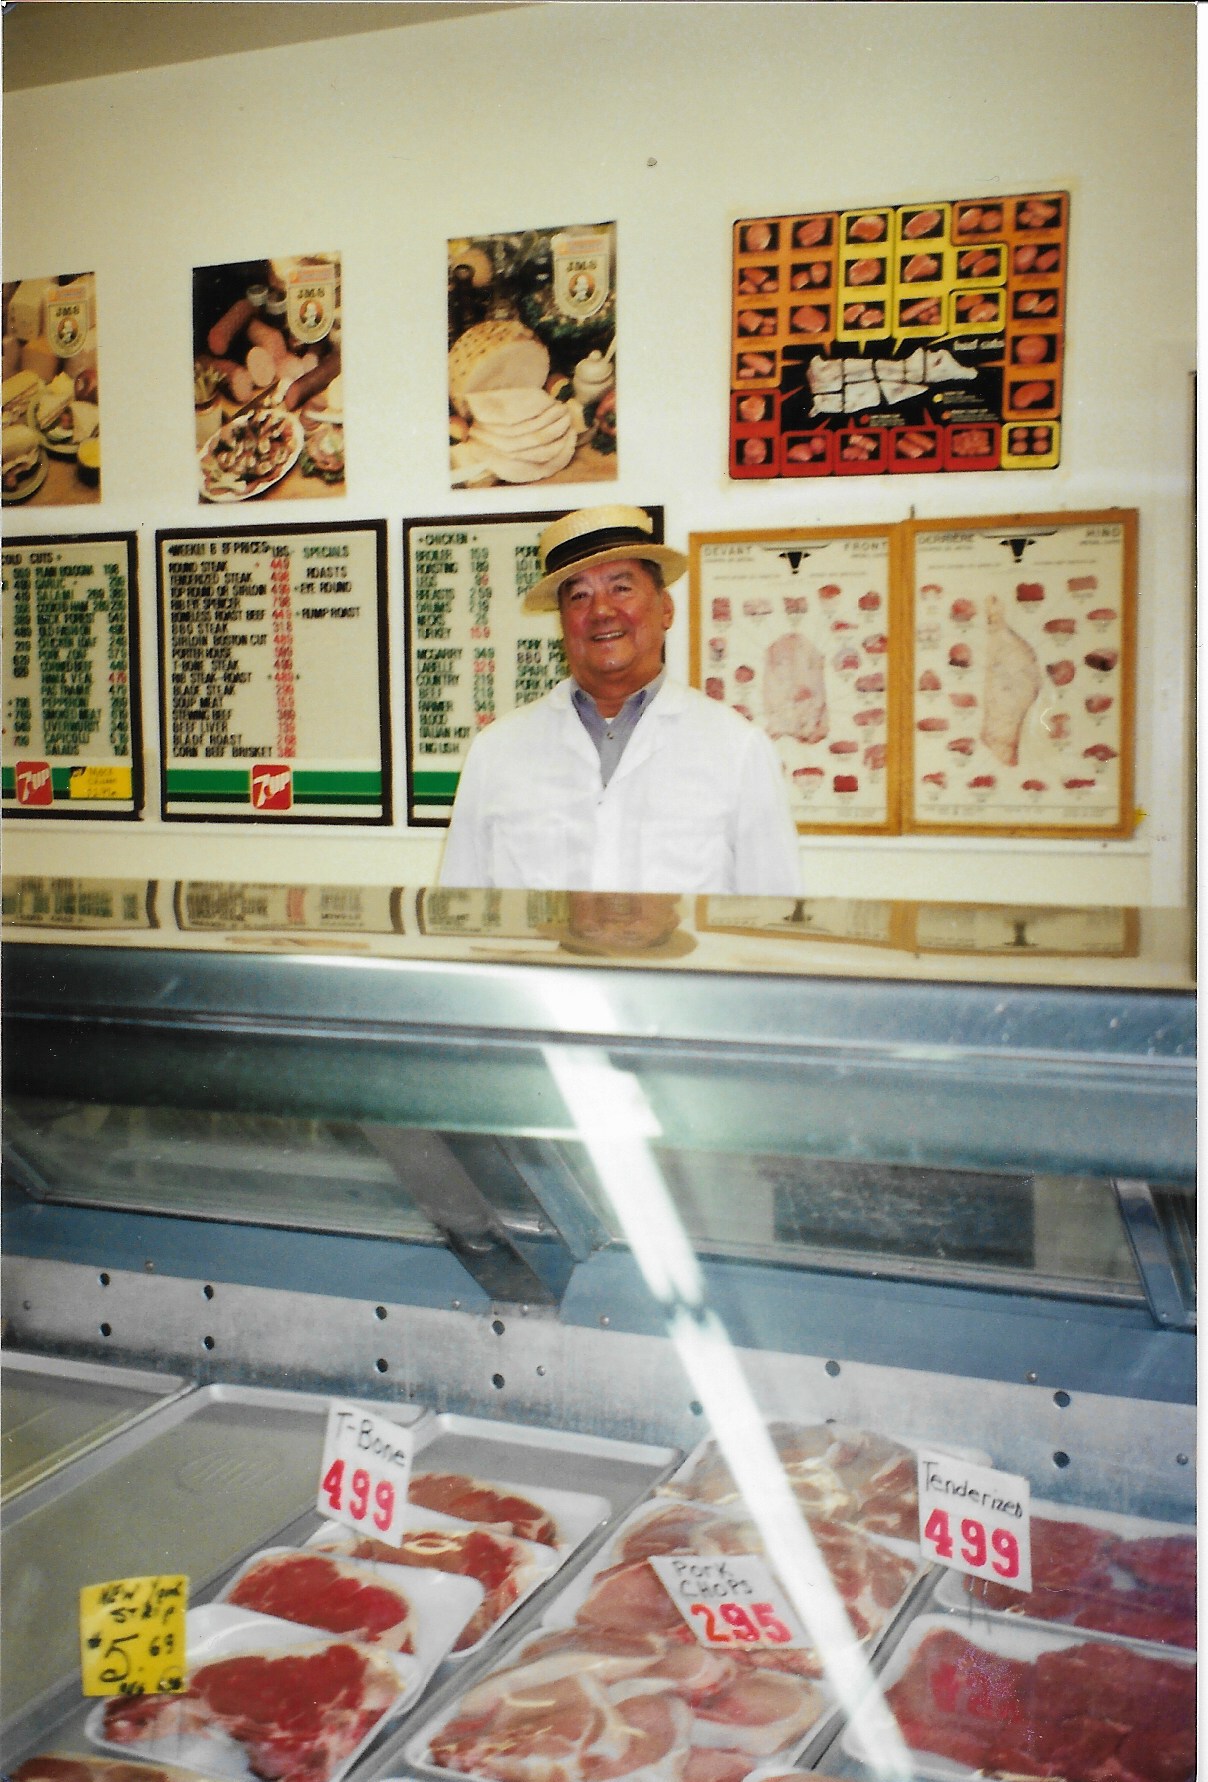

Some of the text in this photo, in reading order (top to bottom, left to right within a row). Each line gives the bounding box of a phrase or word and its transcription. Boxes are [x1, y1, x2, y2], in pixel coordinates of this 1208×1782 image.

[426, 533, 468, 545] CHICKEN
[30, 552, 53, 564] CUTS
[200, 560, 228, 572] STEAK
[306, 566, 348, 578] ROASTS
[224, 572, 253, 583] STEAK
[319, 581, 352, 593] ROUND
[215, 610, 243, 621] ROAST
[302, 606, 361, 620] RUMP ROAST
[197, 622, 228, 633] STEAK
[250, 634, 268, 646] CUT
[211, 660, 240, 671] STEAK
[206, 684, 236, 696] STEAK
[209, 734, 243, 746] ROAST
[232, 746, 273, 758] BRISKET
[337, 1411, 406, 1467] T-Bone
[322, 1458, 396, 1532] 499
[924, 1508, 1020, 1579] 499
[690, 1602, 793, 1643] 295
